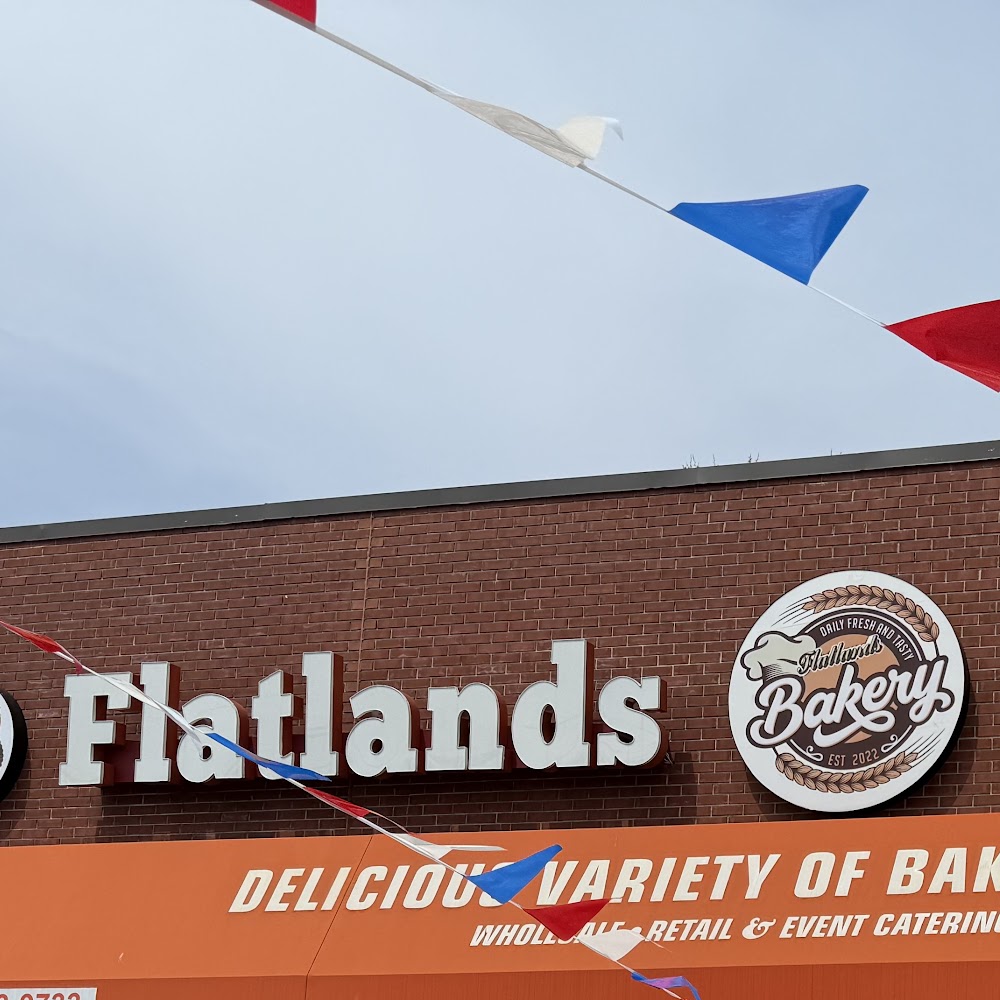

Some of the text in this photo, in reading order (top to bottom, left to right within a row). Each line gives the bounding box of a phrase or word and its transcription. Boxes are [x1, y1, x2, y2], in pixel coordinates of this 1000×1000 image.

[819, 617, 916, 662] DAILY FRESH AND TASTY
[58, 639, 664, 787] Flatlands
[747, 656, 954, 748] Bakery
[827, 747, 880, 767] EST 2022
[536, 852, 780, 906] VARIETY
[794, 849, 871, 899] OF
[470, 920, 626, 947] WHOLAL
[645, 917, 733, 943] RETAIL
[741, 915, 777, 940] &
[779, 913, 870, 939] EVENT
